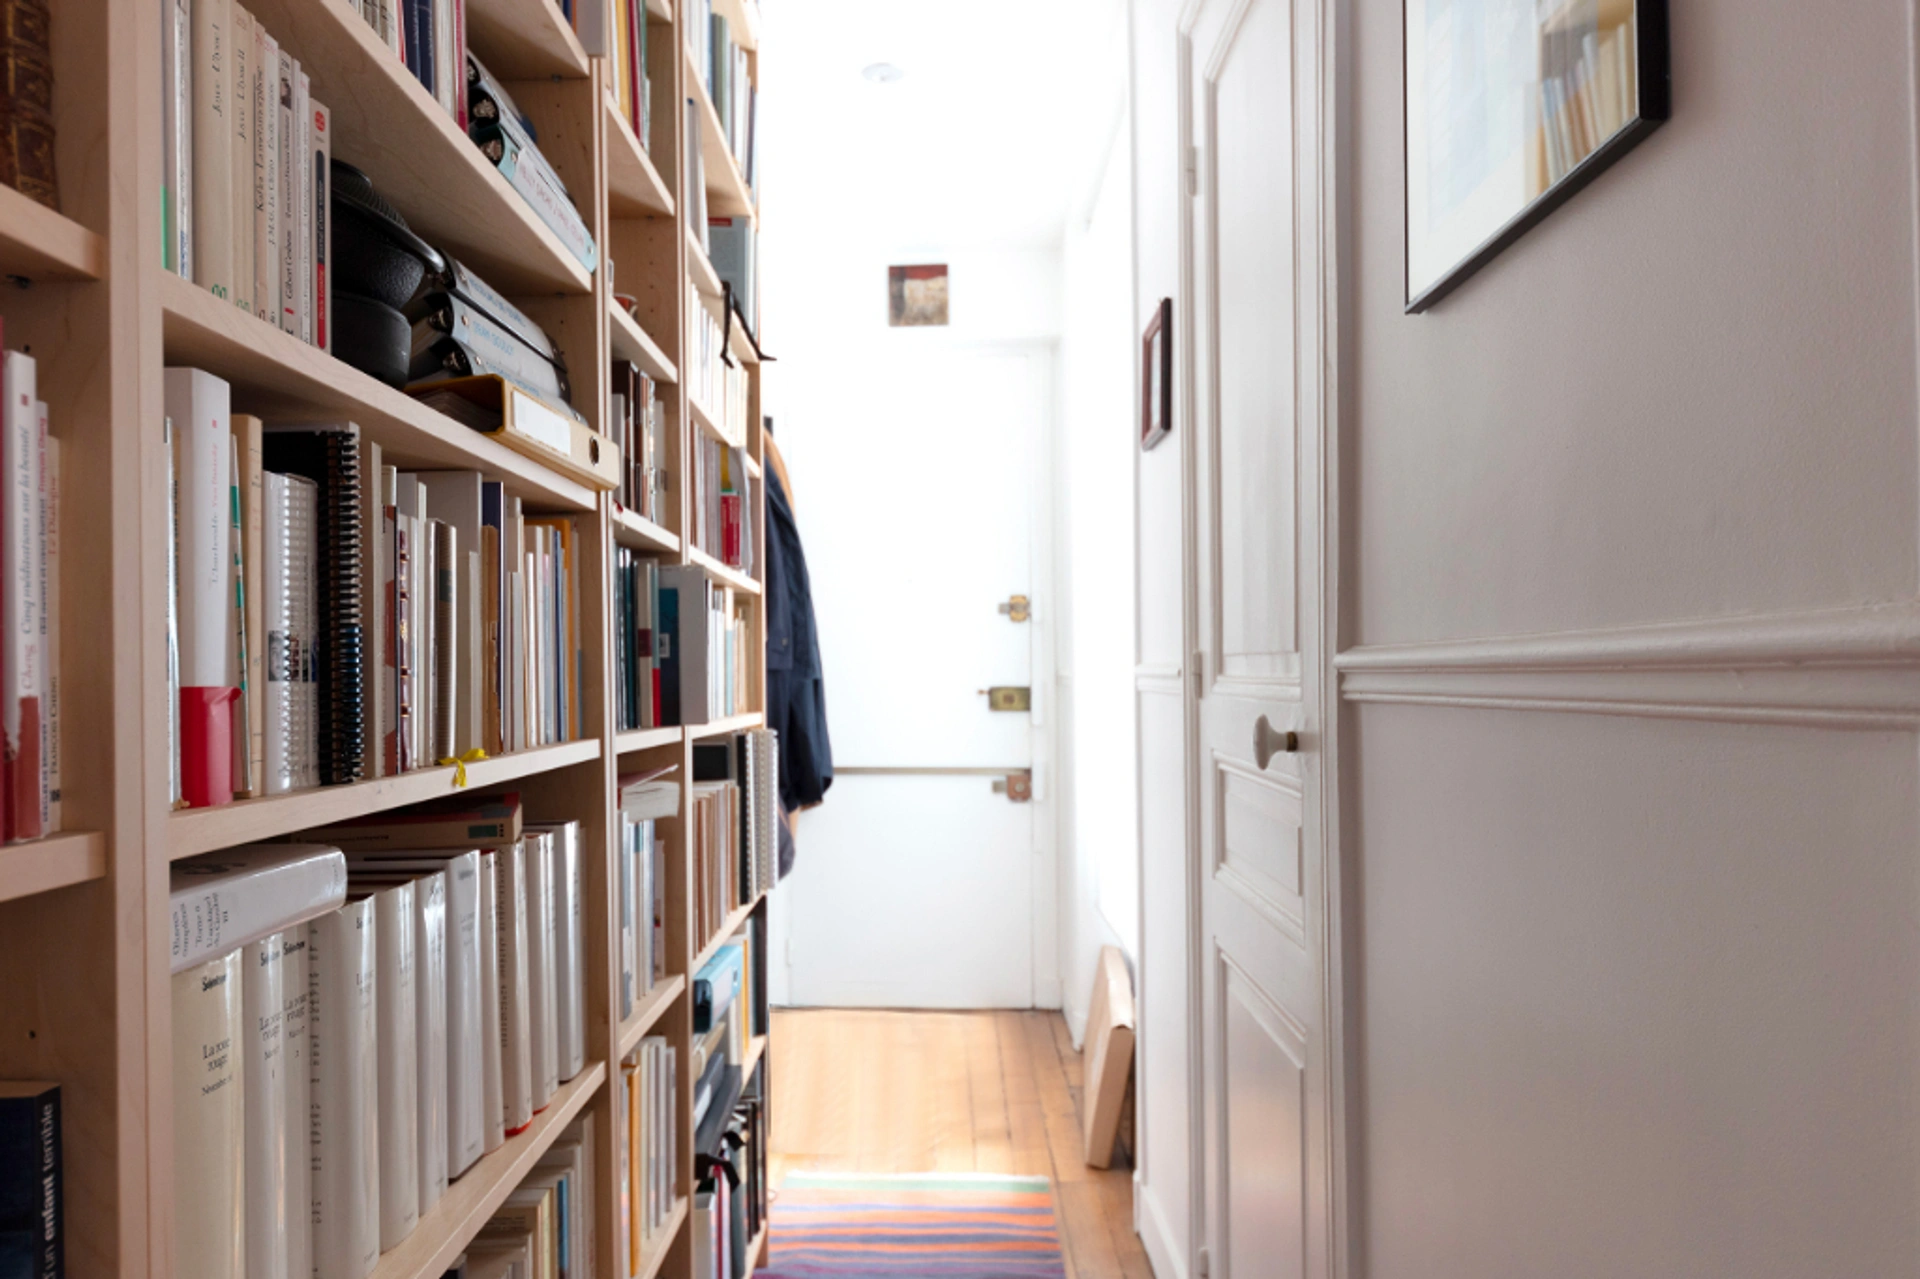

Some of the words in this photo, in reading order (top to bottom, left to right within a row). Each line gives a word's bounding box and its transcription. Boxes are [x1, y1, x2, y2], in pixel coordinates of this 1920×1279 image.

[20, 599, 36, 634] Cinq
[22, 643, 37, 690] Cheng
[41, 1103, 54, 1172] terrible
[41, 1173, 56, 1241] enfant
